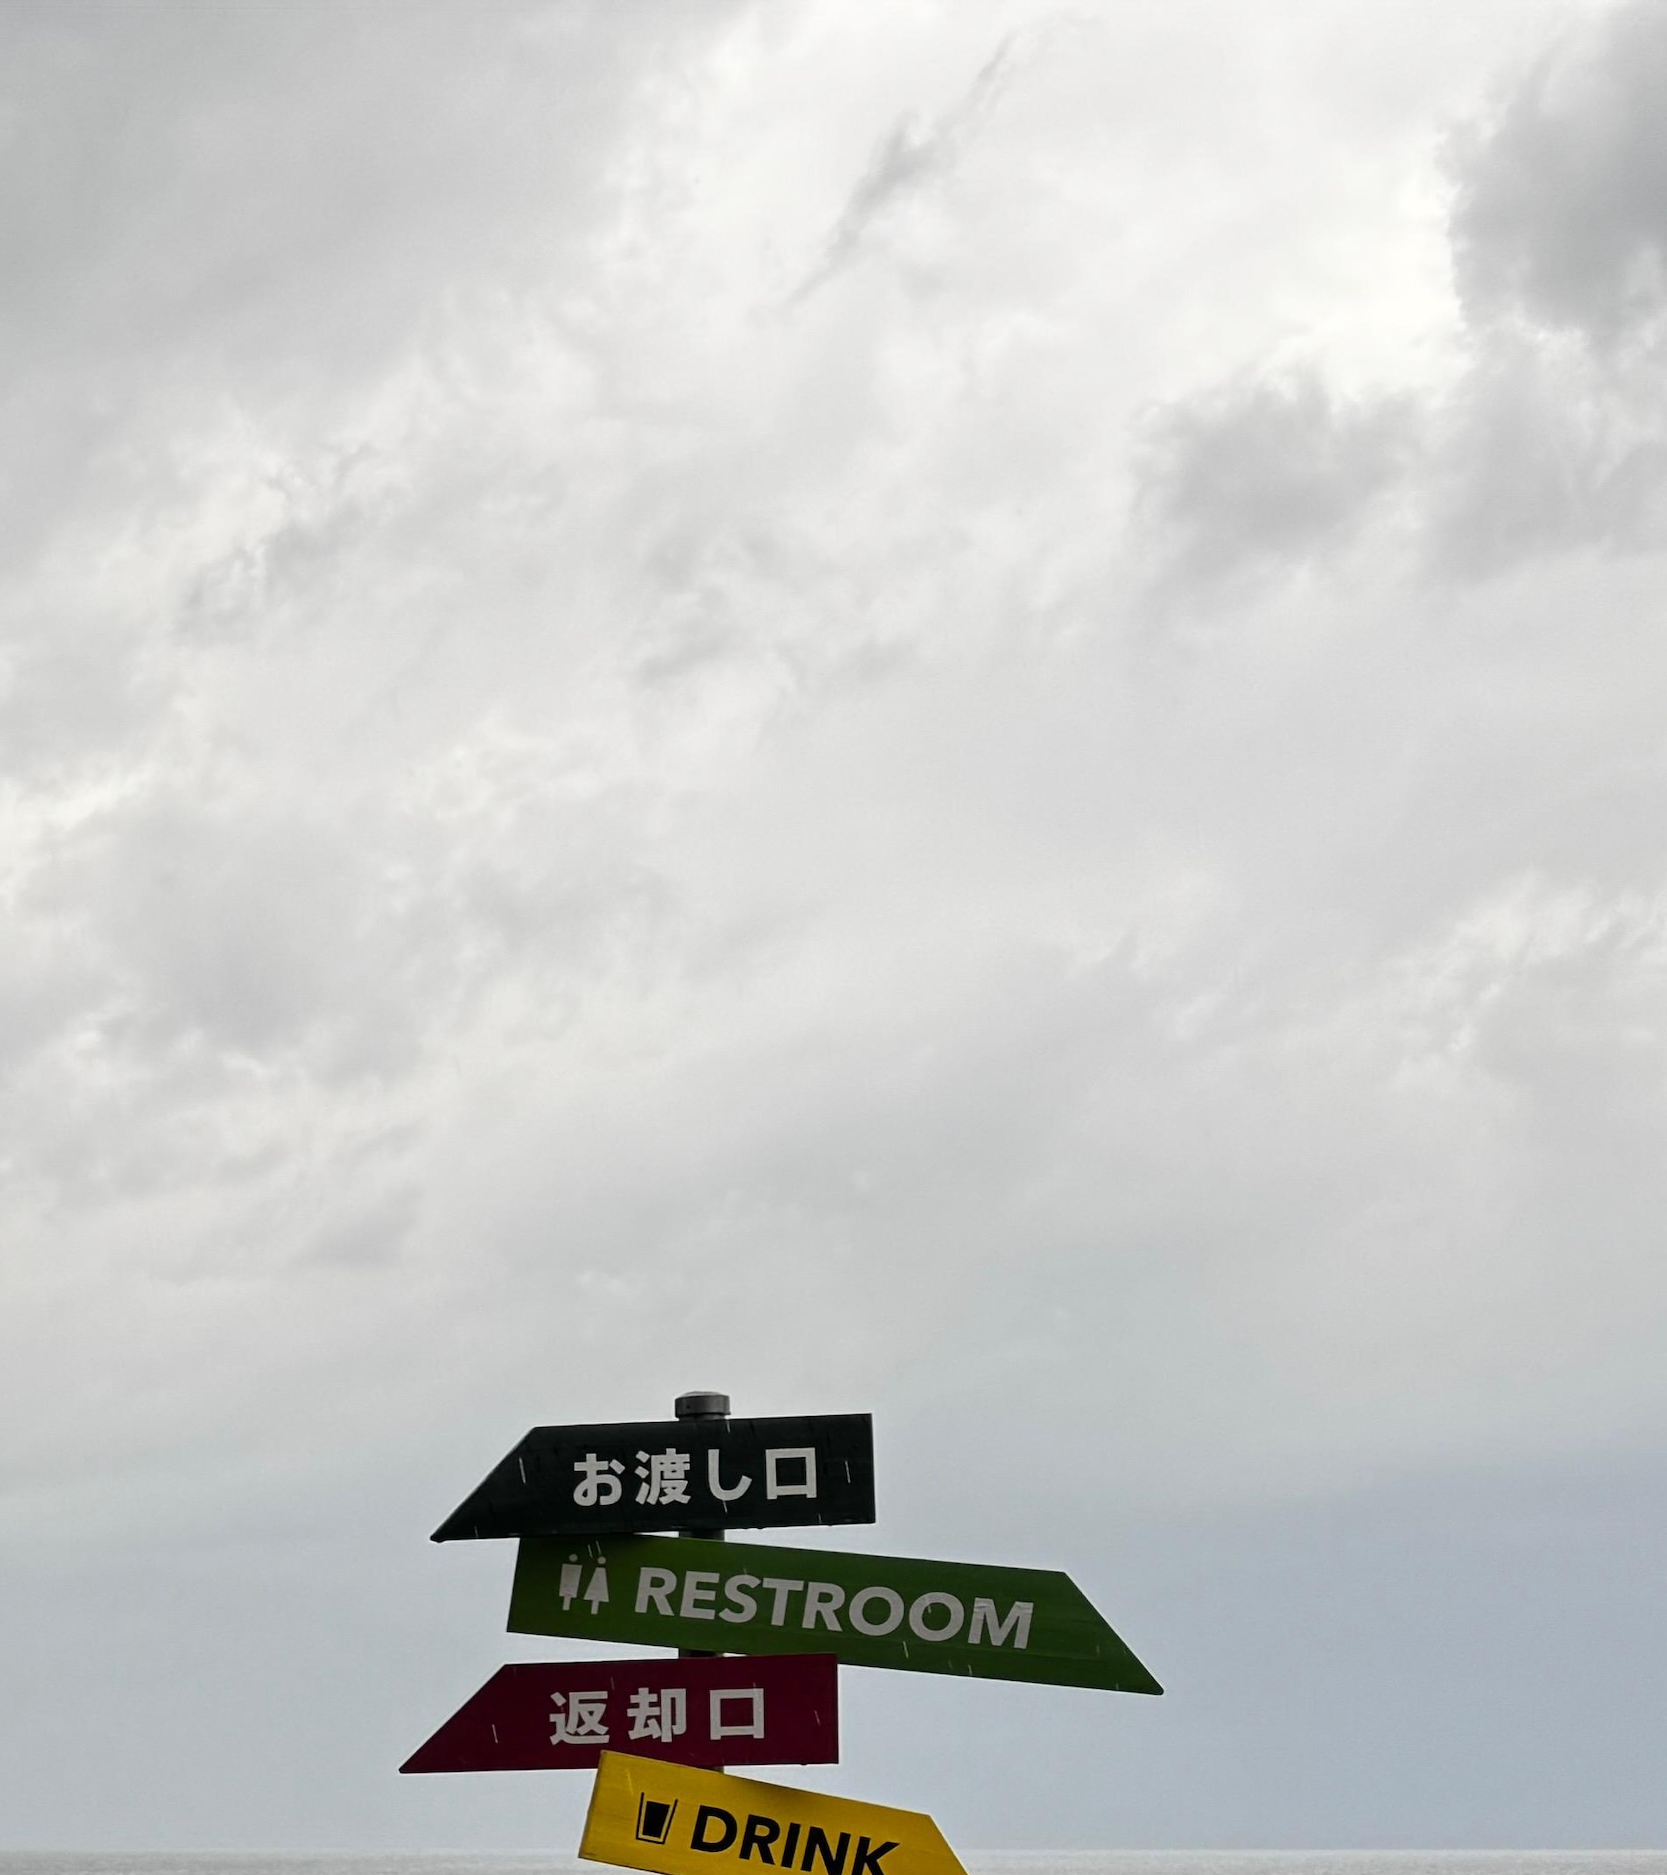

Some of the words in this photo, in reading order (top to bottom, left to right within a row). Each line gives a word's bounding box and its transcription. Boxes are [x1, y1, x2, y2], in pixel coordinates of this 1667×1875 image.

[573, 1447, 817, 1506] お渡し口
[634, 1566, 1034, 1650] RESTROOM
[549, 1687, 765, 1745] 返却口
